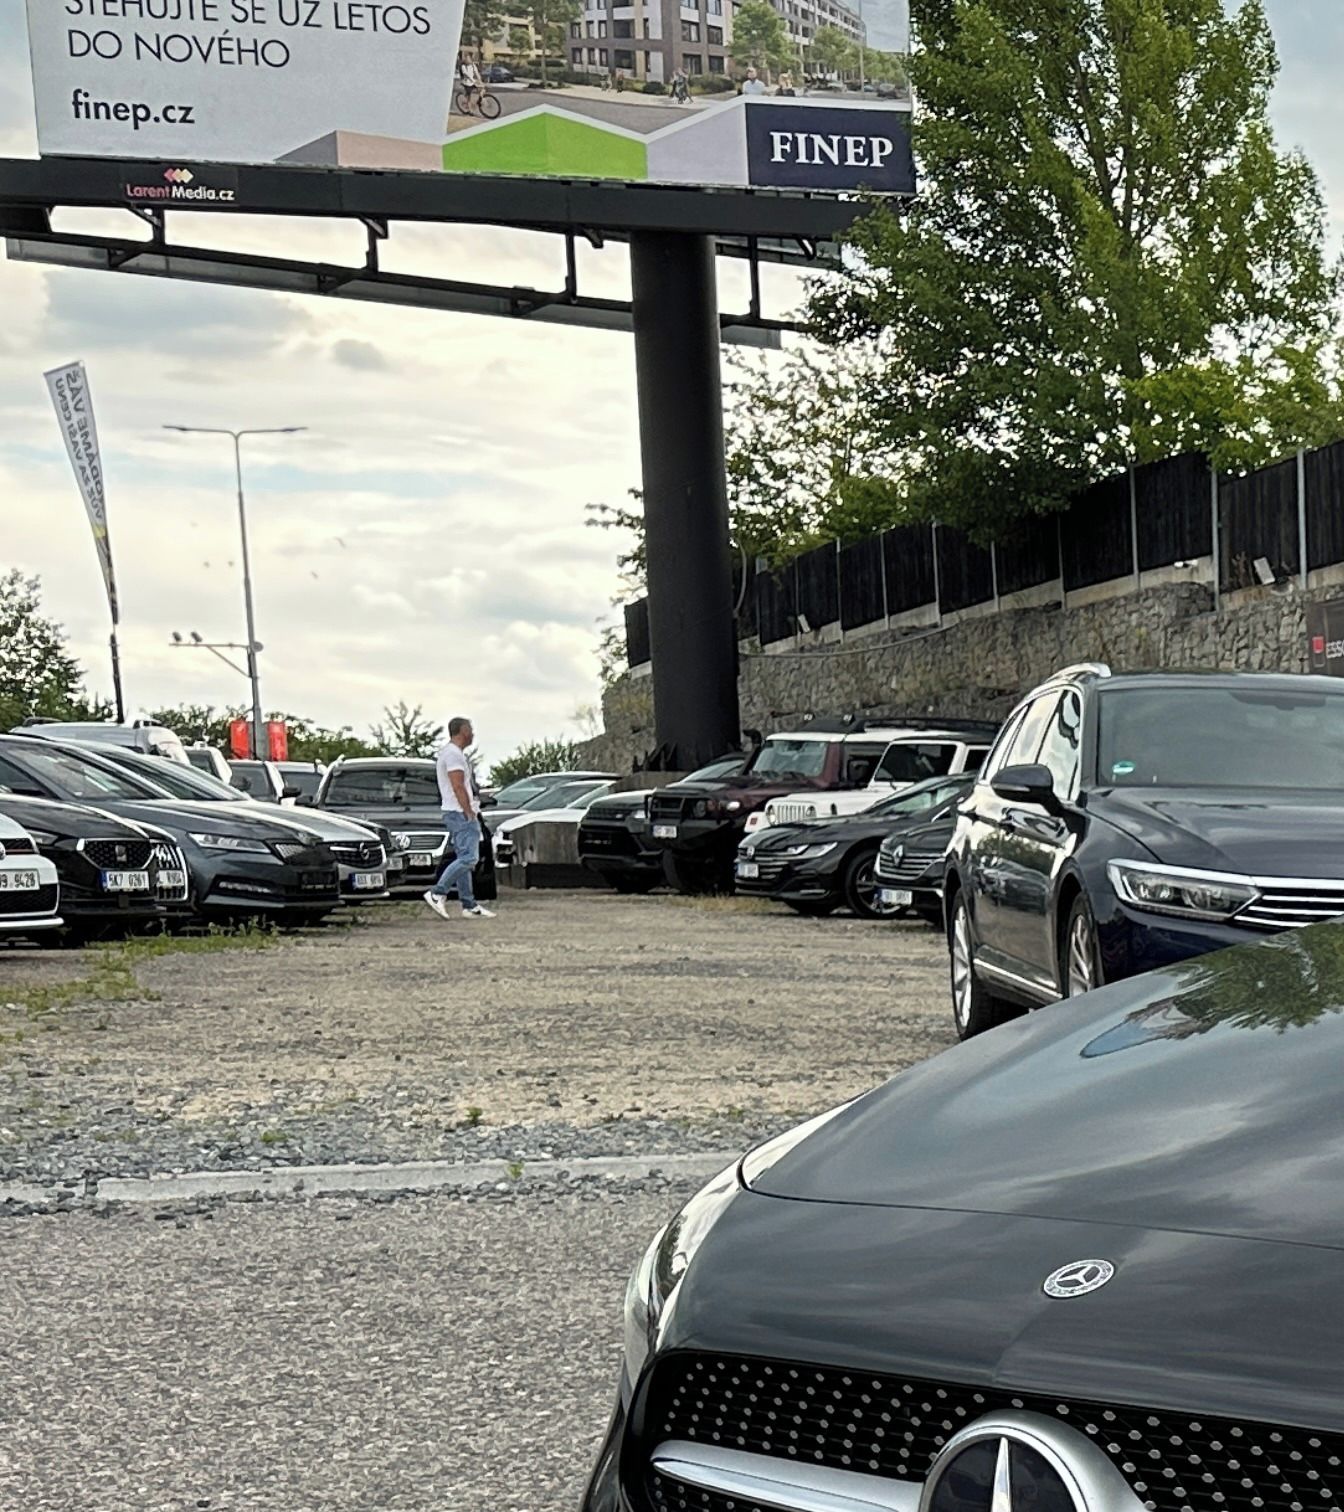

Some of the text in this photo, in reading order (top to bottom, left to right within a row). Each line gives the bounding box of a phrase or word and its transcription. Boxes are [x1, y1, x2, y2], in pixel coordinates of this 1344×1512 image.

[231, 0, 267, 24] SE
[333, 2, 431, 35] LETOS
[68, 29, 290, 67] DO NOVÉHO
[72, 88, 195, 130] finep.cz
[769, 131, 893, 168] FINEP
